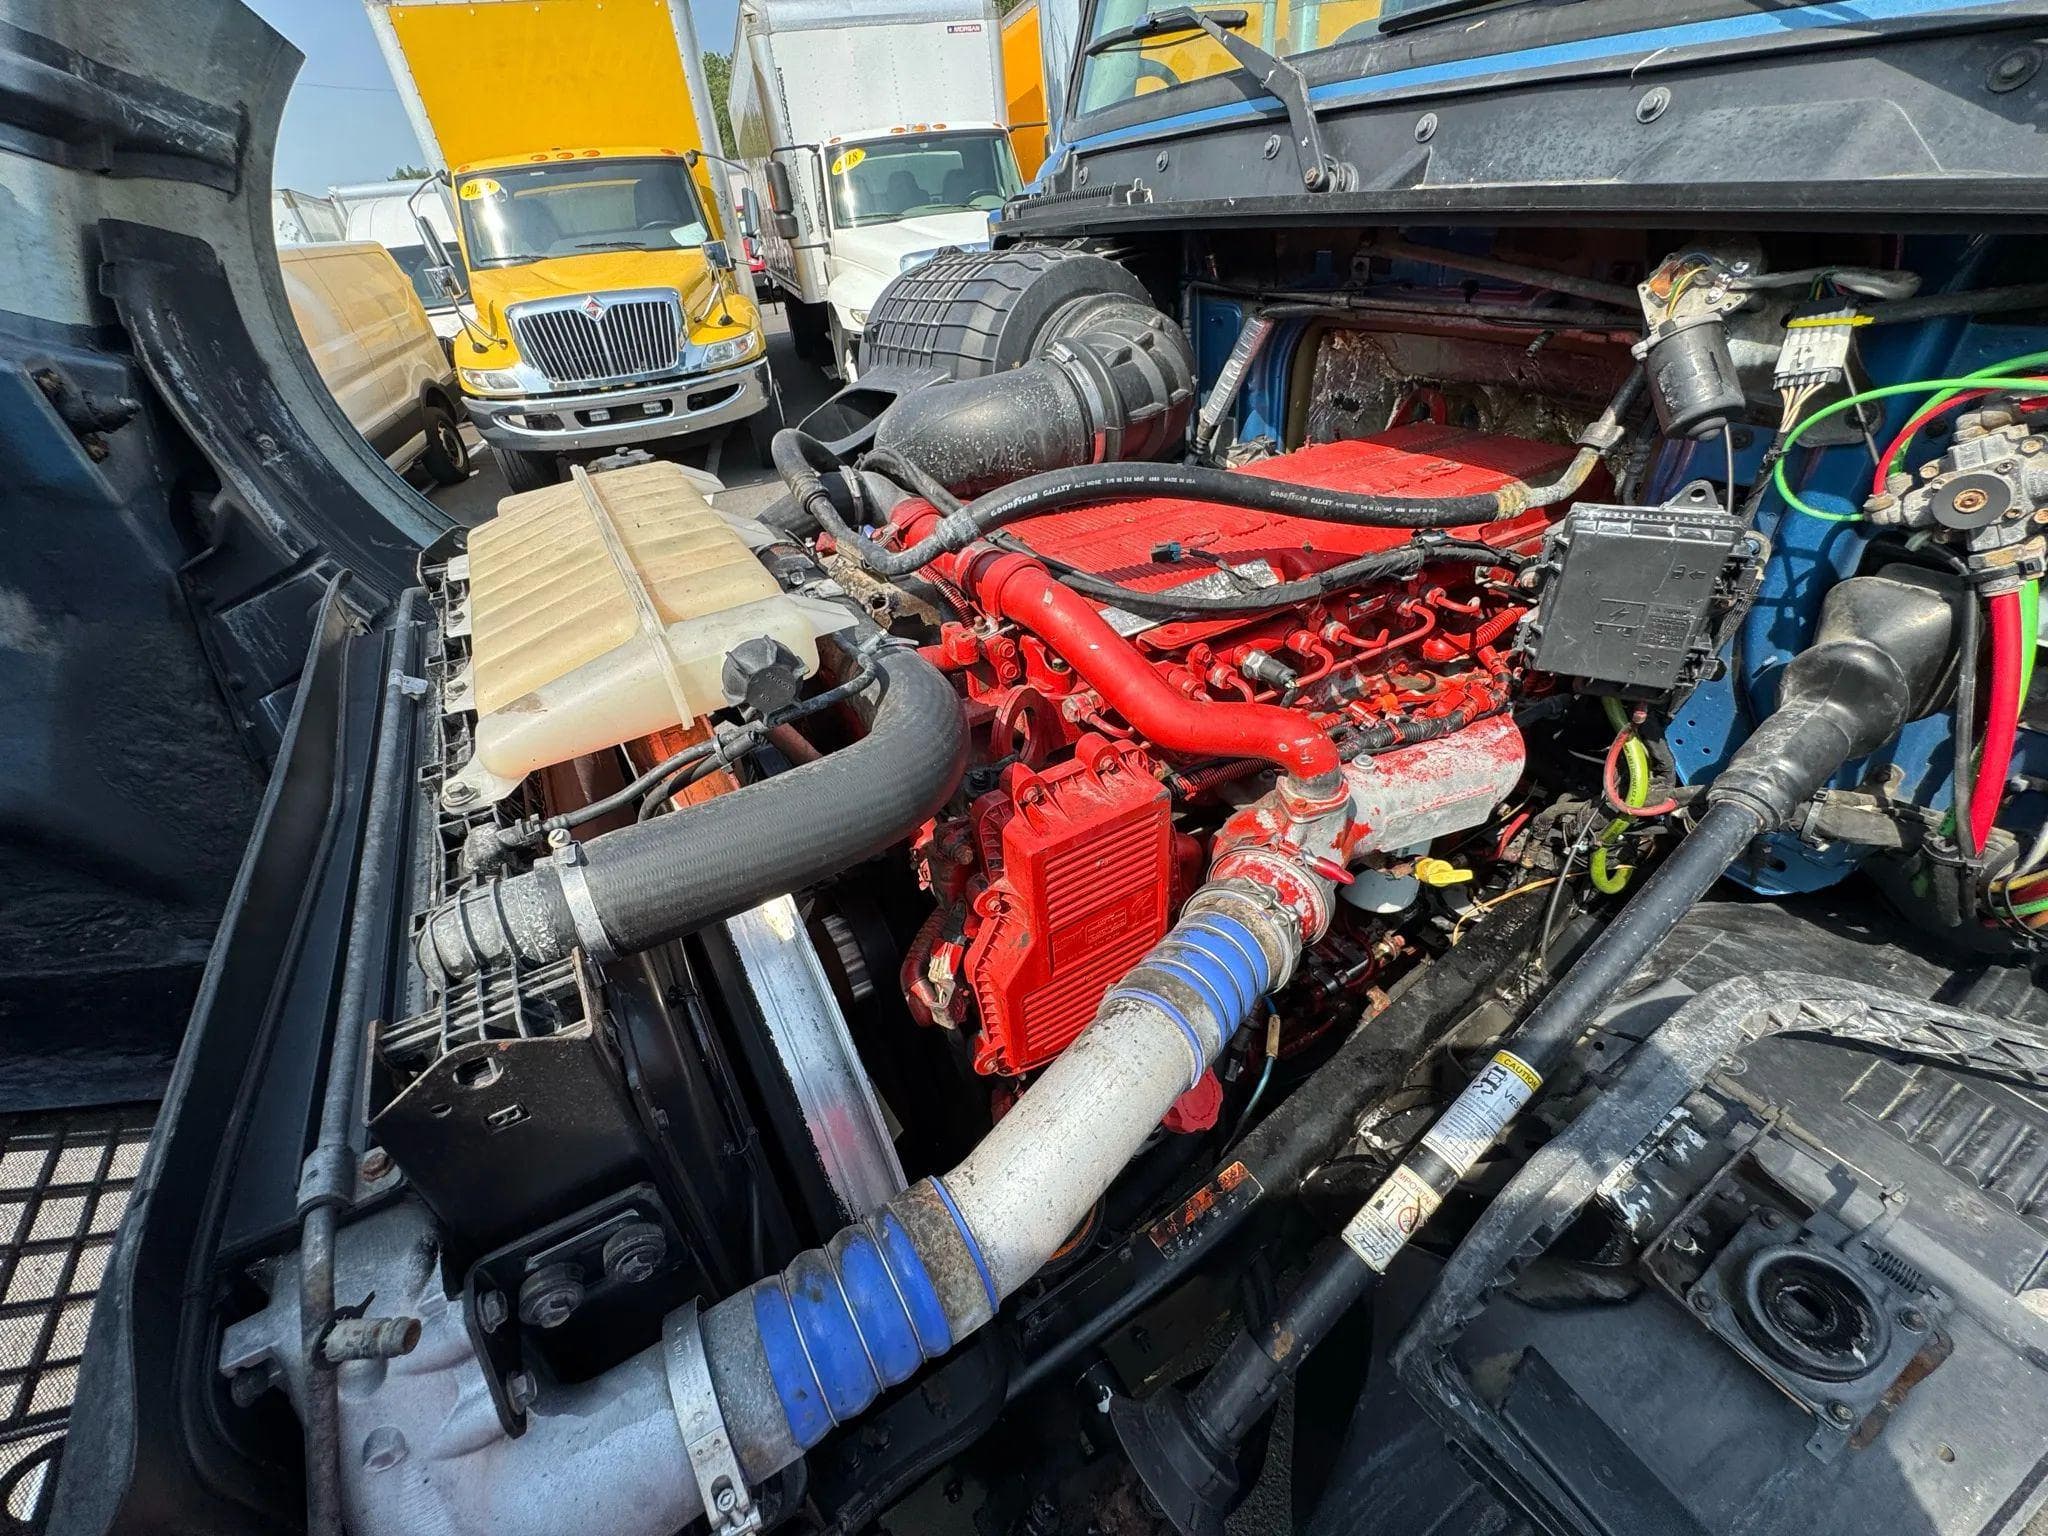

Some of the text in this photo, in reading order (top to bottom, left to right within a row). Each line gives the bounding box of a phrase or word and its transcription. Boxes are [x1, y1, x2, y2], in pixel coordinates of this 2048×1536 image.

[834, 151, 858, 173] 218
[990, 492, 1038, 517] GOODYEAR
[1043, 483, 1071, 497] GALAXY
[1503, 1058, 1538, 1091] CAUTION
